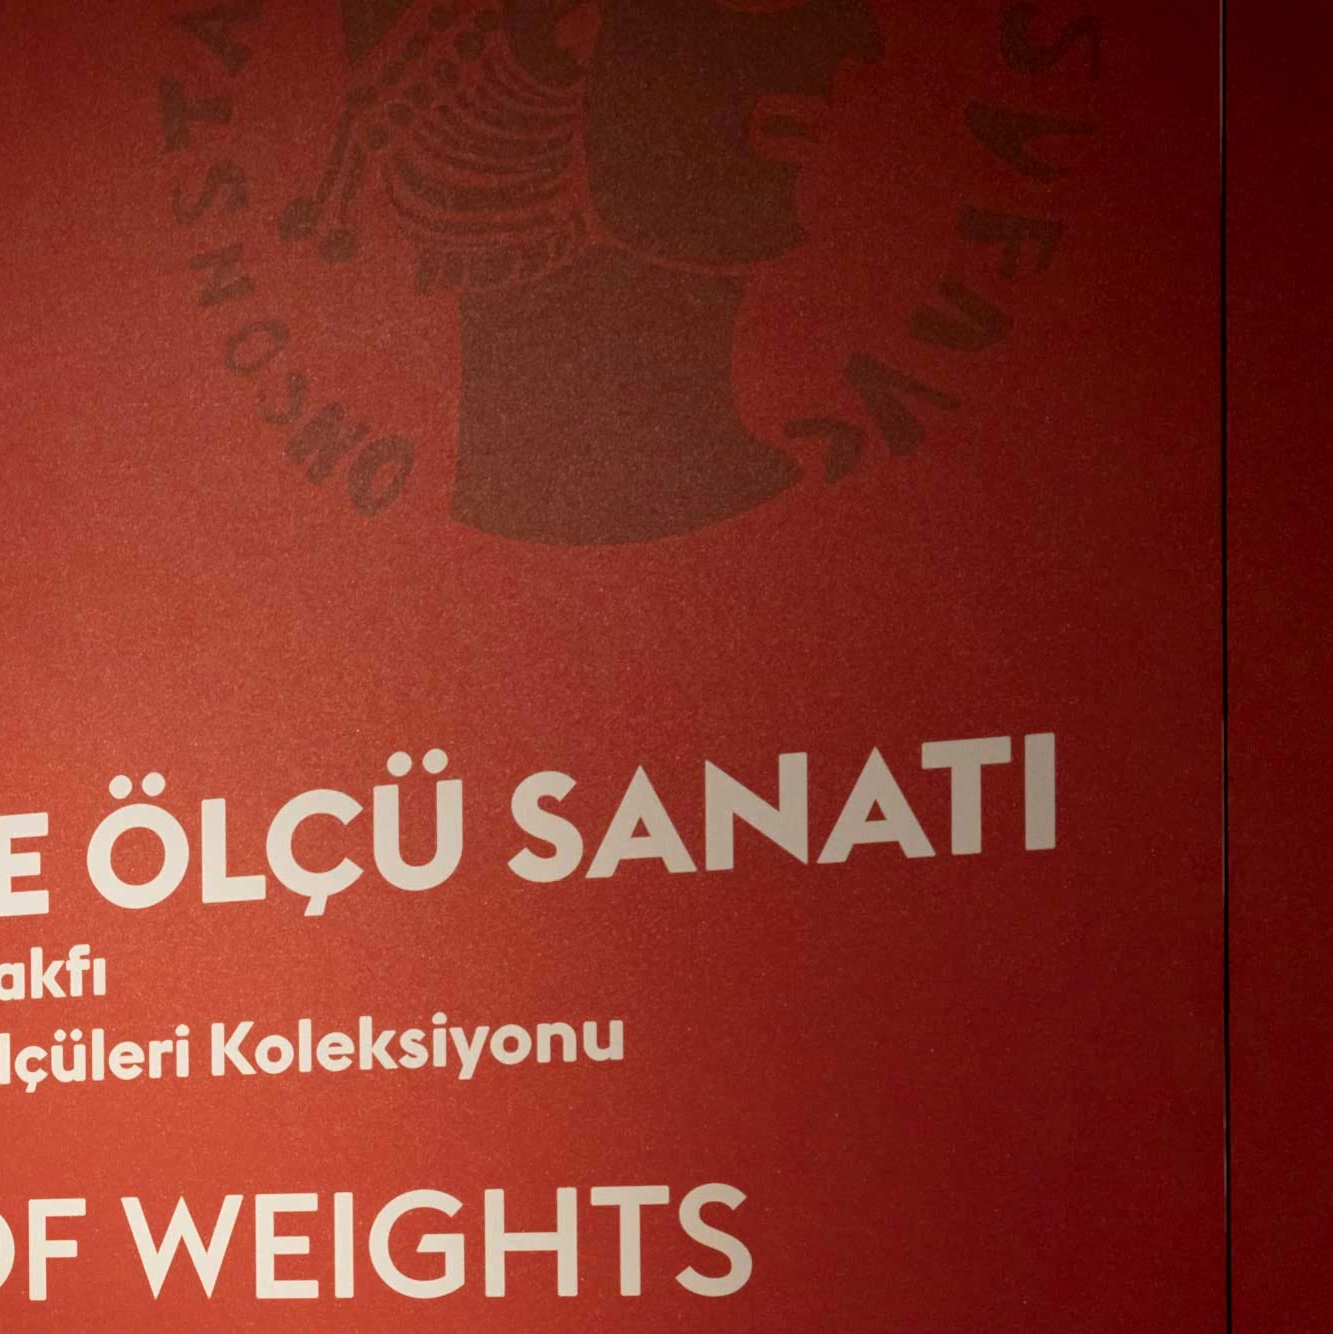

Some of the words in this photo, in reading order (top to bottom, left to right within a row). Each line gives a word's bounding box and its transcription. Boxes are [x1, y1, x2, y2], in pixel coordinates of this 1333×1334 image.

[86, 748, 464, 917] ÖLÇÜ
[507, 734, 1055, 883] SANATI
[210, 1011, 624, 1081] Koleksiyonu
[120, 1182, 753, 1300] WEIGHTS
